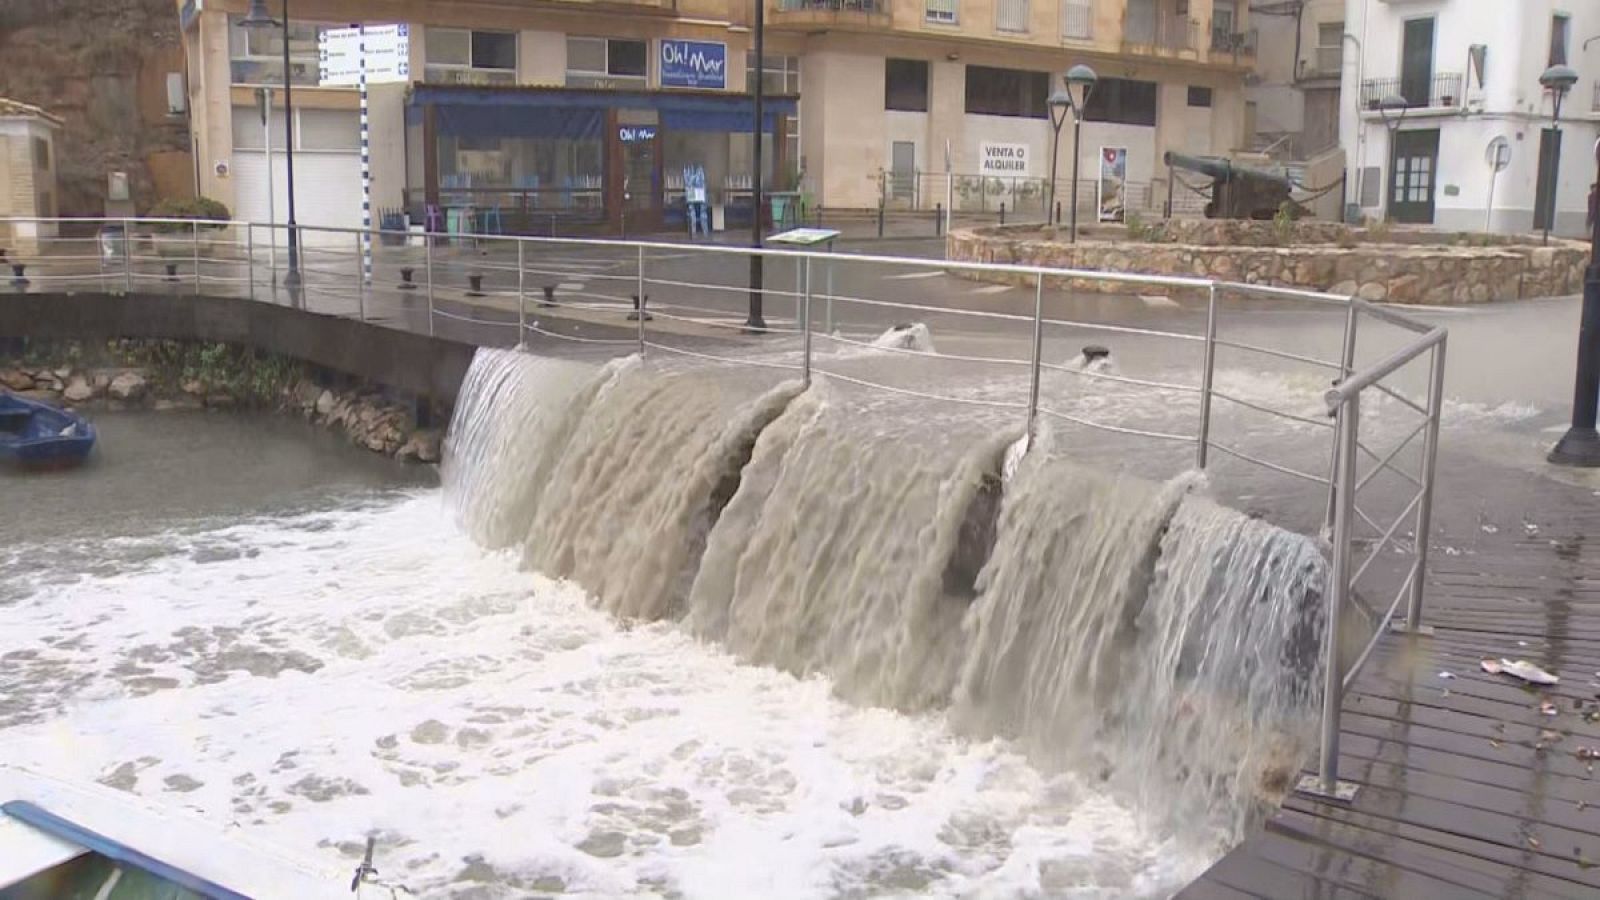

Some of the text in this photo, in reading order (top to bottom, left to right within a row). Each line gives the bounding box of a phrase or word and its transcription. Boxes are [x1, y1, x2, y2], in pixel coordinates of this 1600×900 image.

[663, 43, 723, 72] Oh! Mar
[620, 128, 656, 141] Oh! Mar
[985, 146, 1025, 158] VENTA O
[984, 160, 1025, 170] ALQUILER
